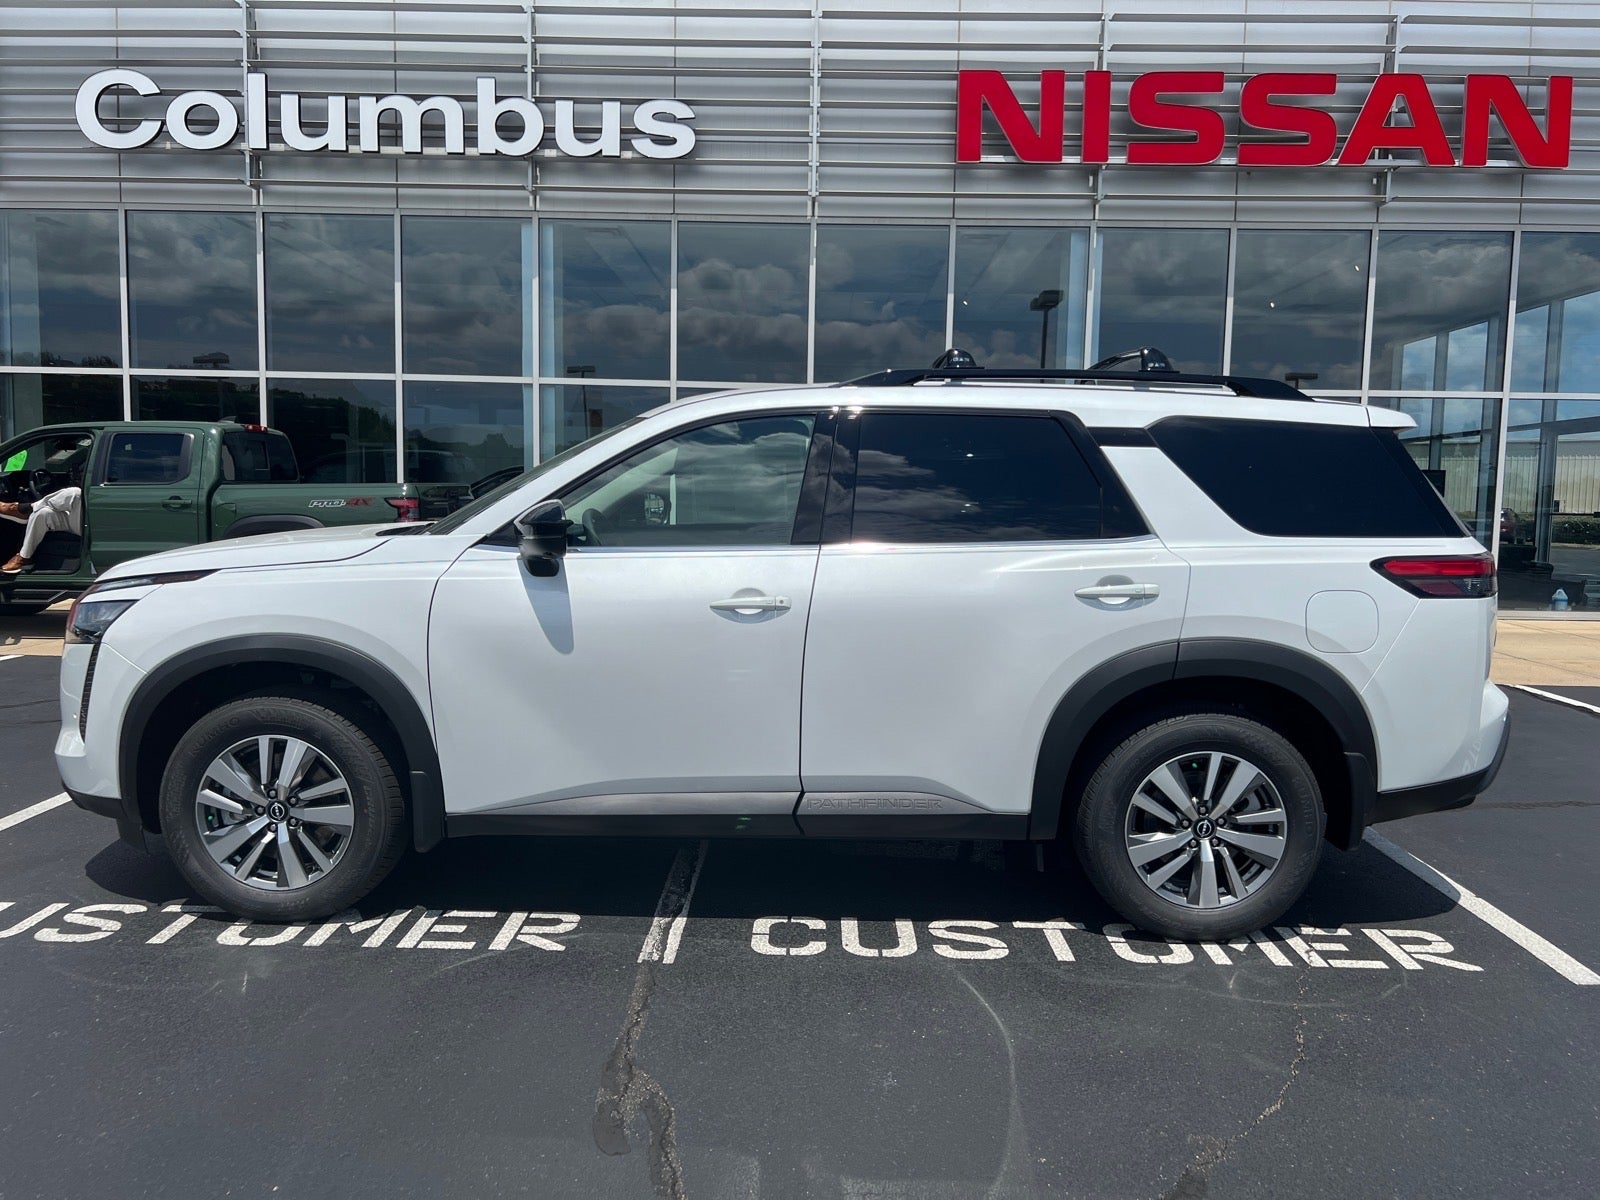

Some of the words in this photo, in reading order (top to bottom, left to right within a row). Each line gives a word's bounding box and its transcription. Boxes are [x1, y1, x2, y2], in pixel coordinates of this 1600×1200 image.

[75, 68, 697, 160] Columbus
[956, 70, 1573, 170] NISSAN
[807, 798, 944, 810] PATHFINDER
[751, 914, 1485, 972] CUSTOMER
